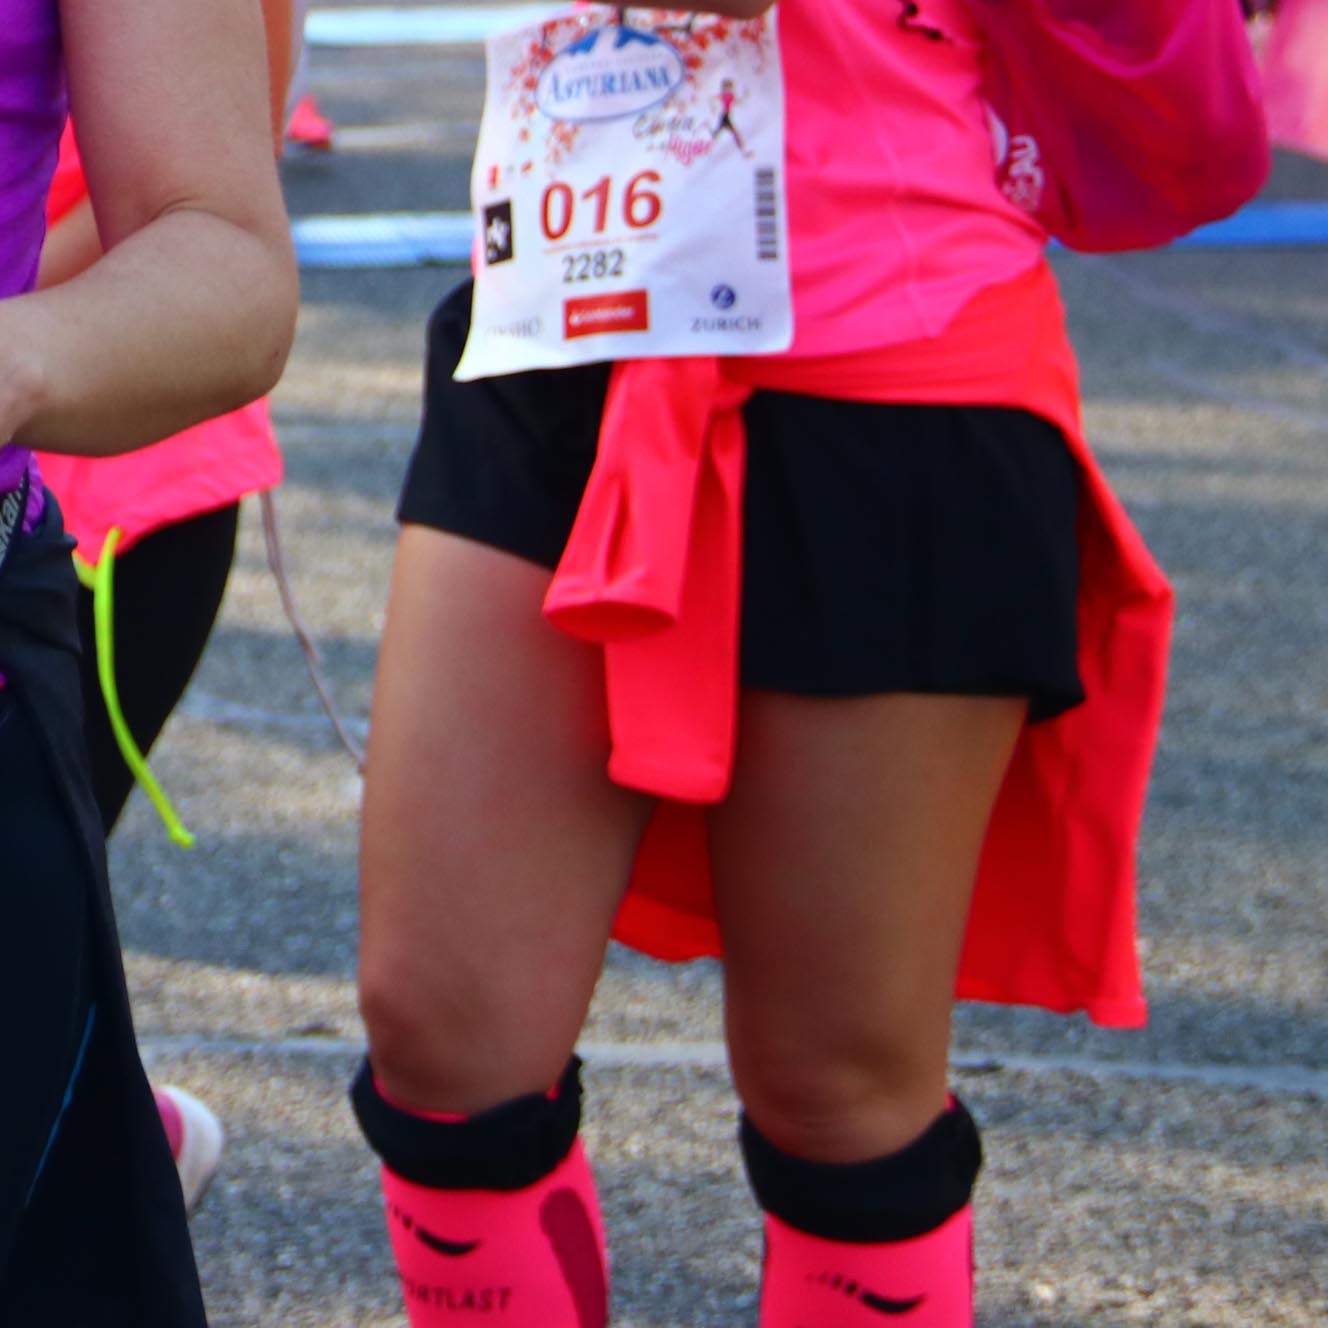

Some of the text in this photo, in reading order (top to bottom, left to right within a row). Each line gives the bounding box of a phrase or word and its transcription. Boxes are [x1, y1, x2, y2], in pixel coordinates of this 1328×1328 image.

[550, 65, 671, 102] ASTURIANA
[539, 169, 662, 240] 016
[561, 249, 624, 283] 2282
[690, 316, 761, 333] ZURICH
